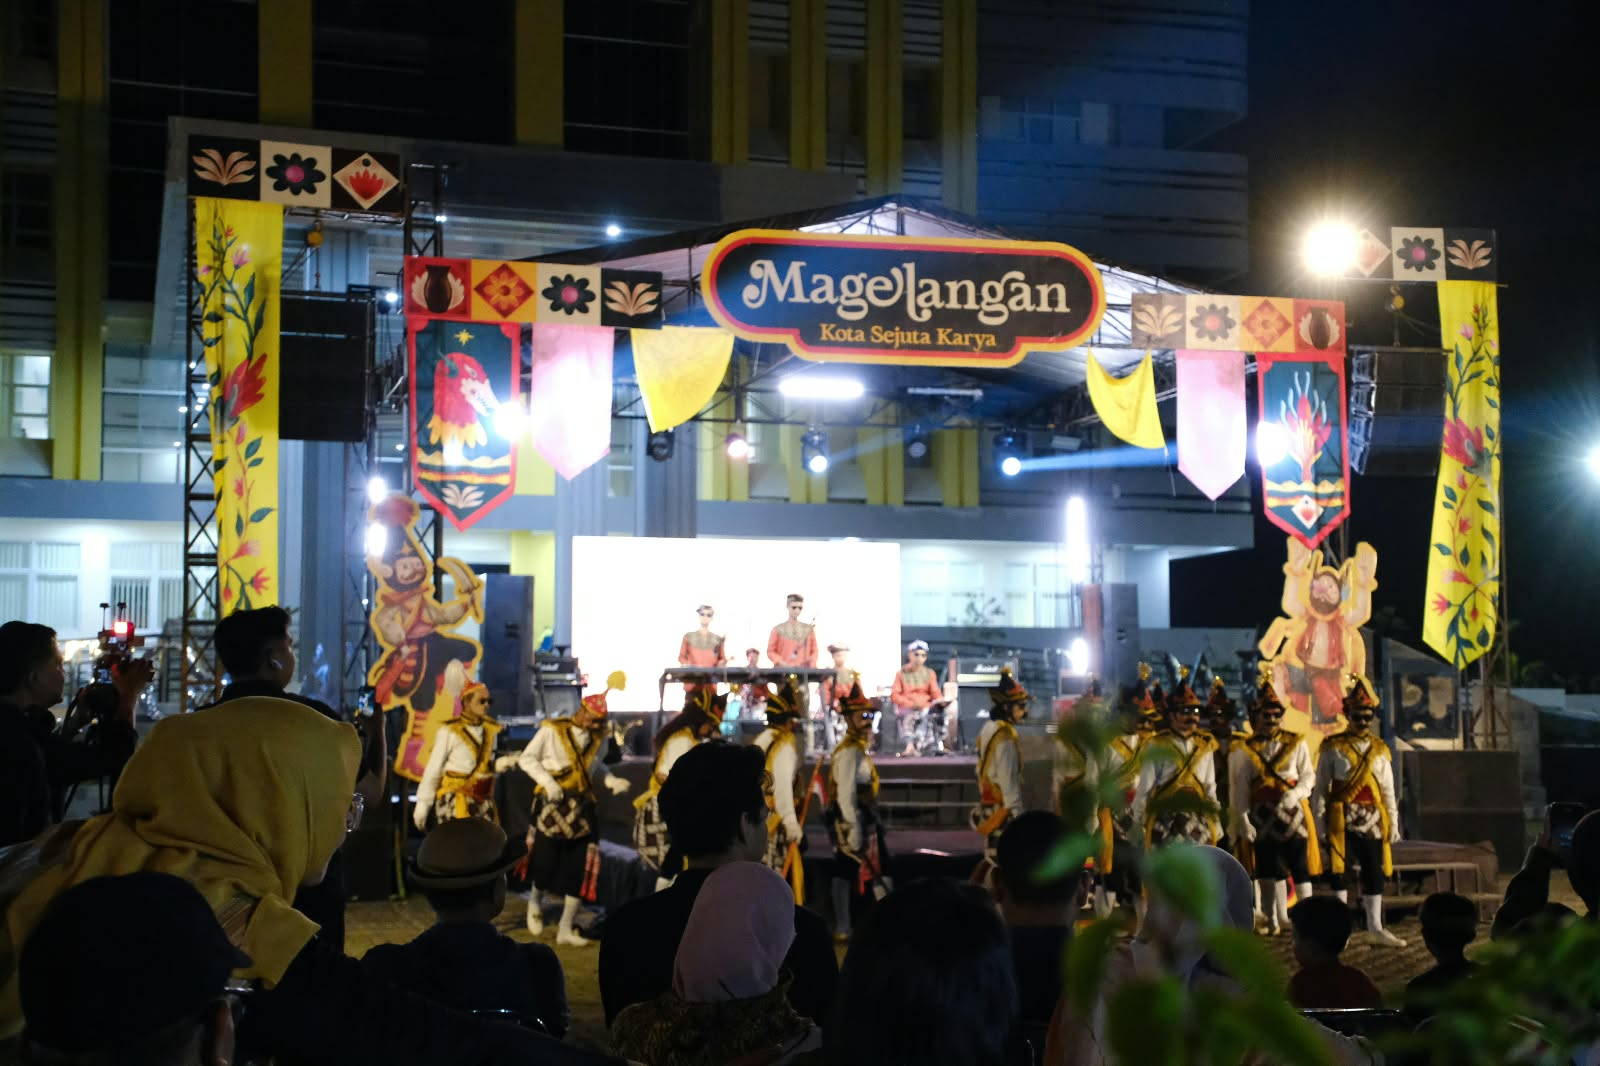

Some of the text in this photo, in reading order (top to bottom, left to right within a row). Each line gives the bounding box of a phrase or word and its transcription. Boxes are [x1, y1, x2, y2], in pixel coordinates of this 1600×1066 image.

[742, 259, 1071, 326] Magelangan
[819, 323, 997, 351] Kota Sejuta Karya
